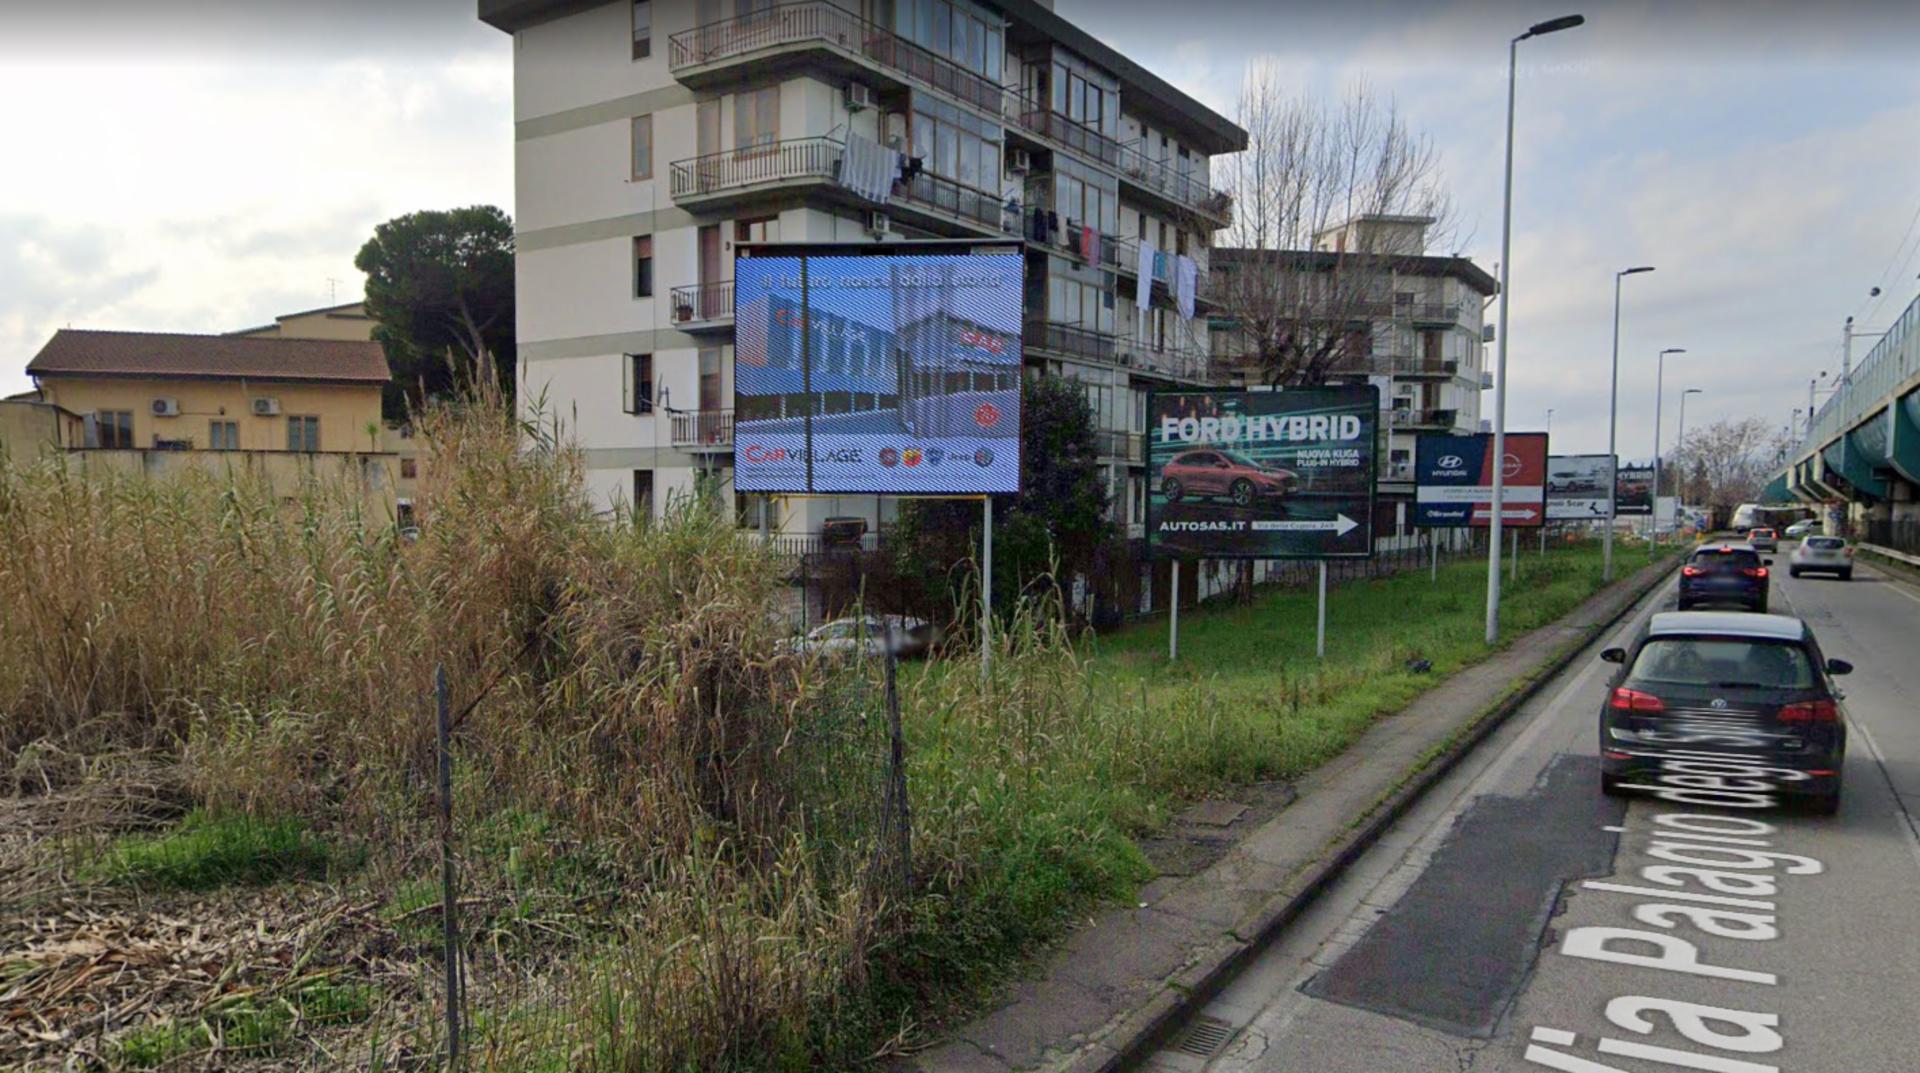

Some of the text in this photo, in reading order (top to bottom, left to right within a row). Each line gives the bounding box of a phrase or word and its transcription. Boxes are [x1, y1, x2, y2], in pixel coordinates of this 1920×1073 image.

[1161, 414, 1361, 442] FORD HYBRID
[1296, 449, 1360, 459] NUOVA KUGA
[1296, 459, 1360, 468] PLUG-IN HYBRID
[1159, 520, 1246, 533] AUTOSAS.IT
